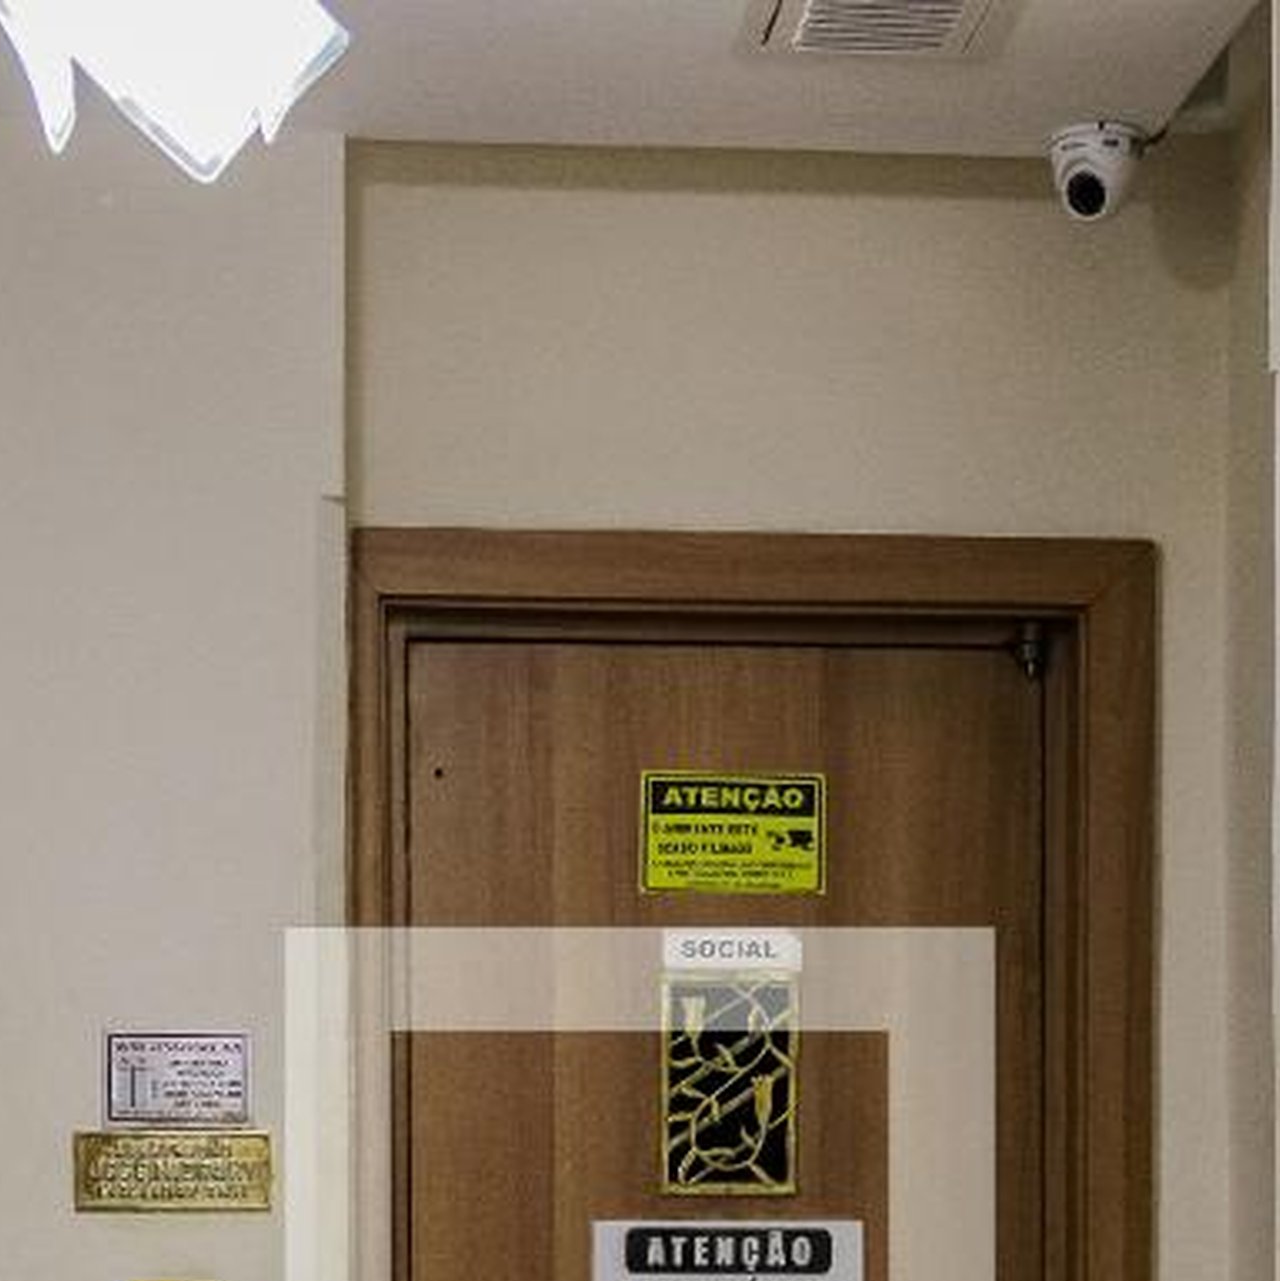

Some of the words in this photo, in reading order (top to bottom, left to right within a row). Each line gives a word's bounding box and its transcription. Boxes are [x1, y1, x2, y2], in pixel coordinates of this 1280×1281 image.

[663, 784, 804, 812] ATENÇÃO
[680, 940, 777, 958] SOCIAL
[646, 1230, 813, 1271] ATENÇÃO
